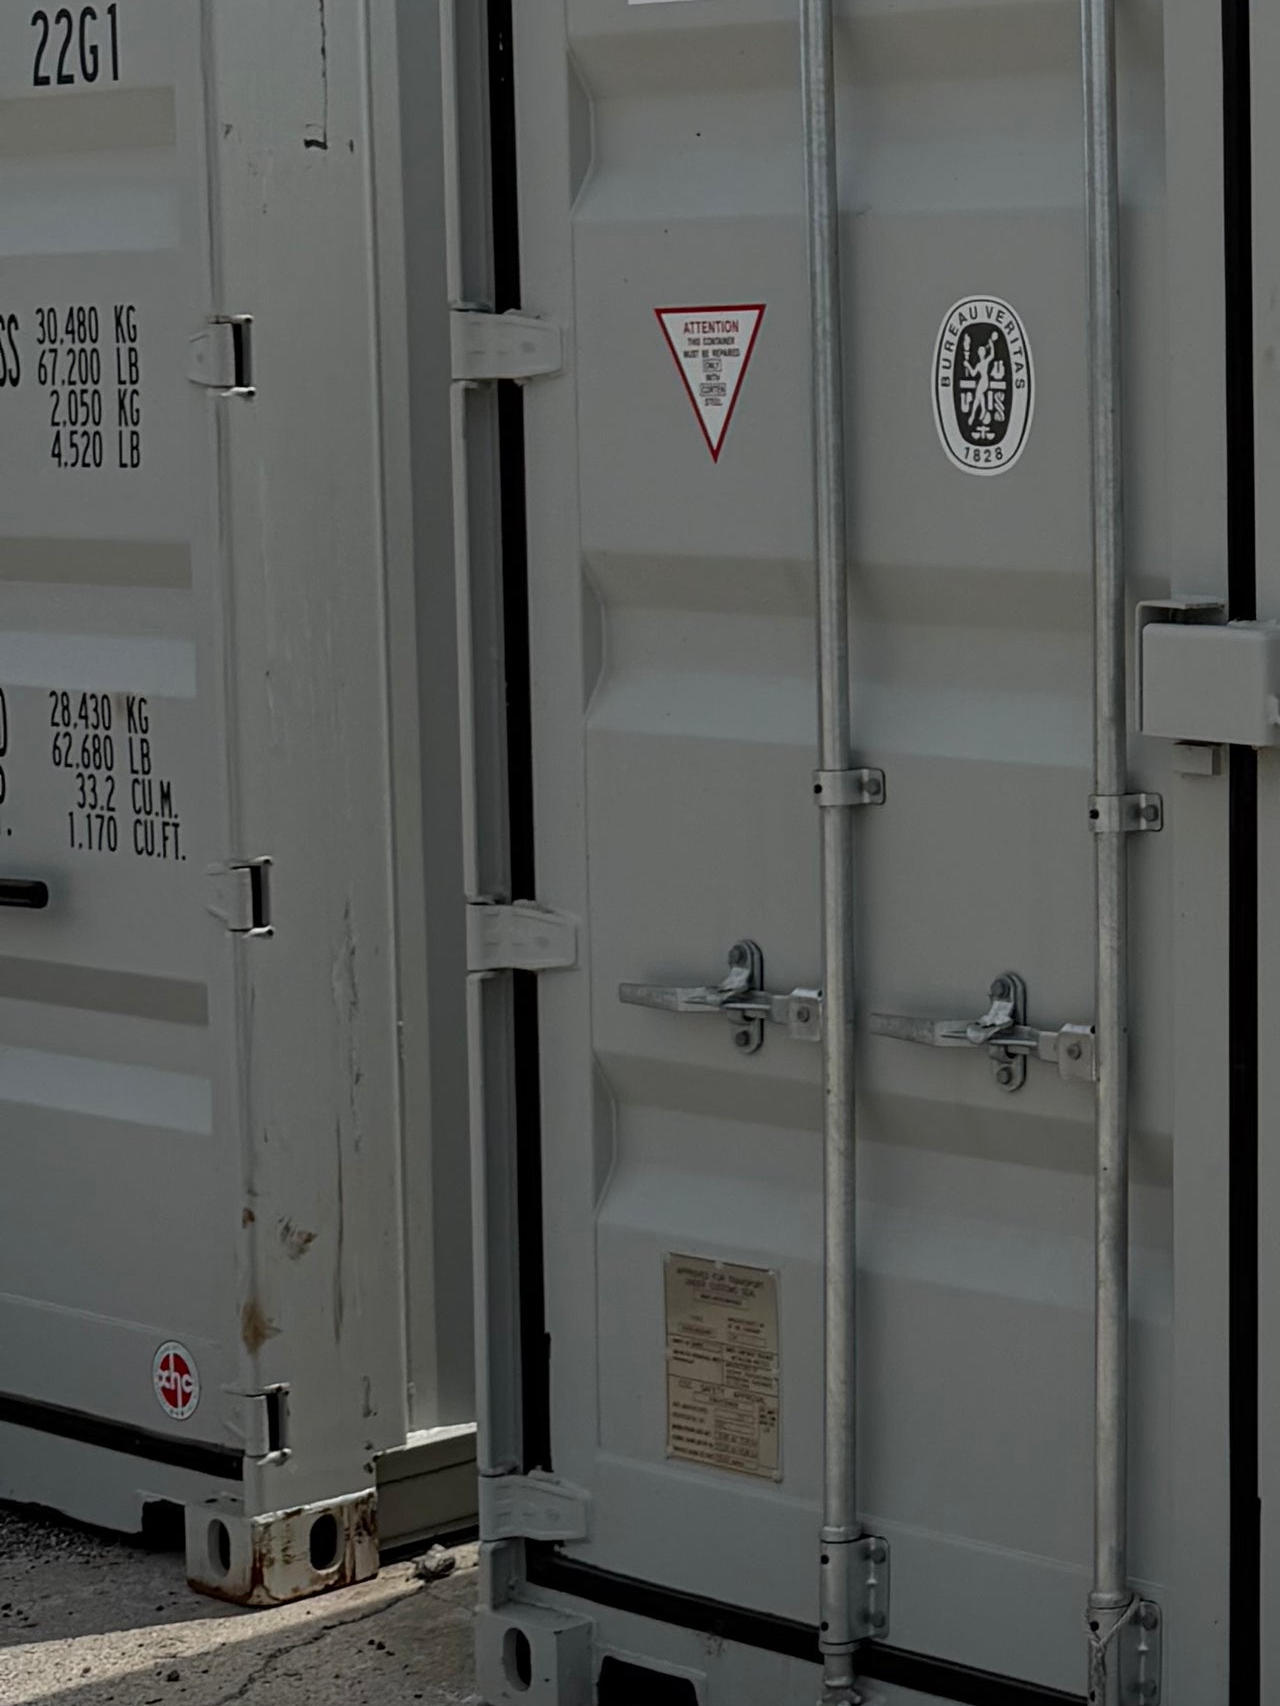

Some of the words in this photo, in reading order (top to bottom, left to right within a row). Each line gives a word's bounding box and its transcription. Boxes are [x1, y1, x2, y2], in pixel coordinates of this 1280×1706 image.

[31, 3, 119, 86] 22G1
[114, 304, 137, 343] KG
[683, 320, 739, 334] ATTENTION
[117, 347, 139, 385] LB
[941, 305, 978, 388] BUREAU
[985, 305, 1025, 390] VERITAS
[118, 388, 140, 427] KG
[119, 430, 140, 468] LB
[964, 446, 1003, 463] 1828
[127, 695, 149, 734] KG
[129, 736, 151, 775] LB
[76, 772, 116, 812] 33.2
[132, 778, 178, 819] CU.M.
[134, 818, 186, 860] CU.FT.
